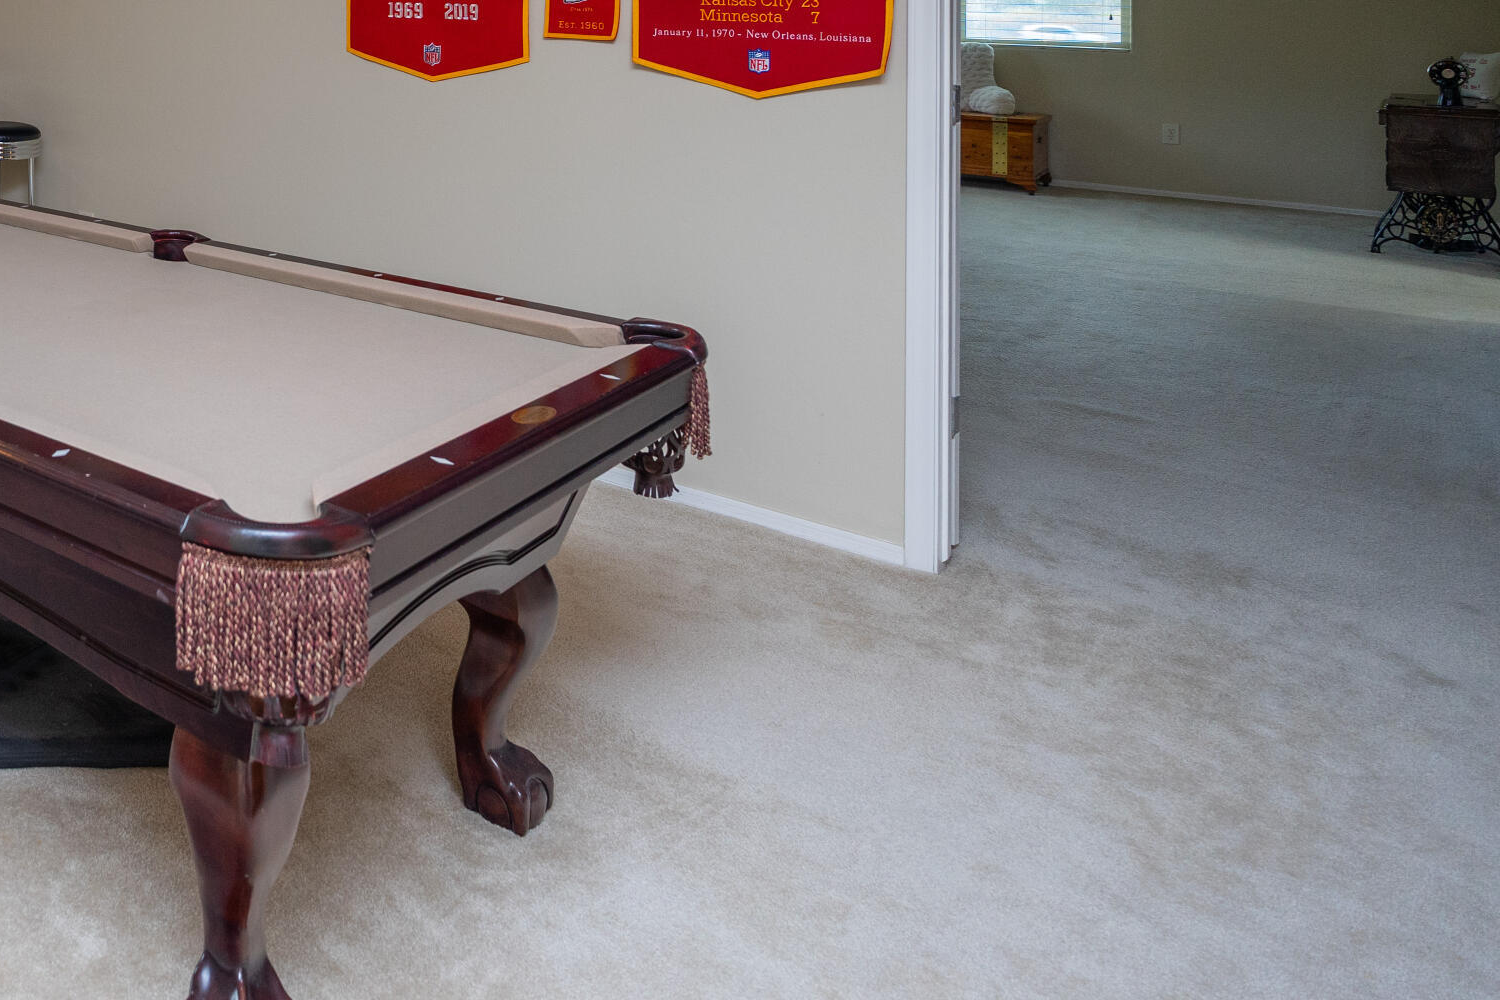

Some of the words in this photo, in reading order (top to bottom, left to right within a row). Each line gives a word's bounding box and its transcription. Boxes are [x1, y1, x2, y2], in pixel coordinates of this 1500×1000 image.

[388, 1, 424, 19] 1969
[444, 2, 479, 21] 2019
[700, 8, 783, 23] Minnesota
[811, 11, 820, 24] 7
[580, 21, 605, 30] 1960
[652, 28, 692, 38] January
[696, 28, 709, 38] 11,
[712, 29, 735, 38] 1970
[746, 29, 769, 39] New
[772, 30, 817, 41] Orleans,
[819, 32, 872, 43] Louisiana
[750, 59, 769, 71] NFL
